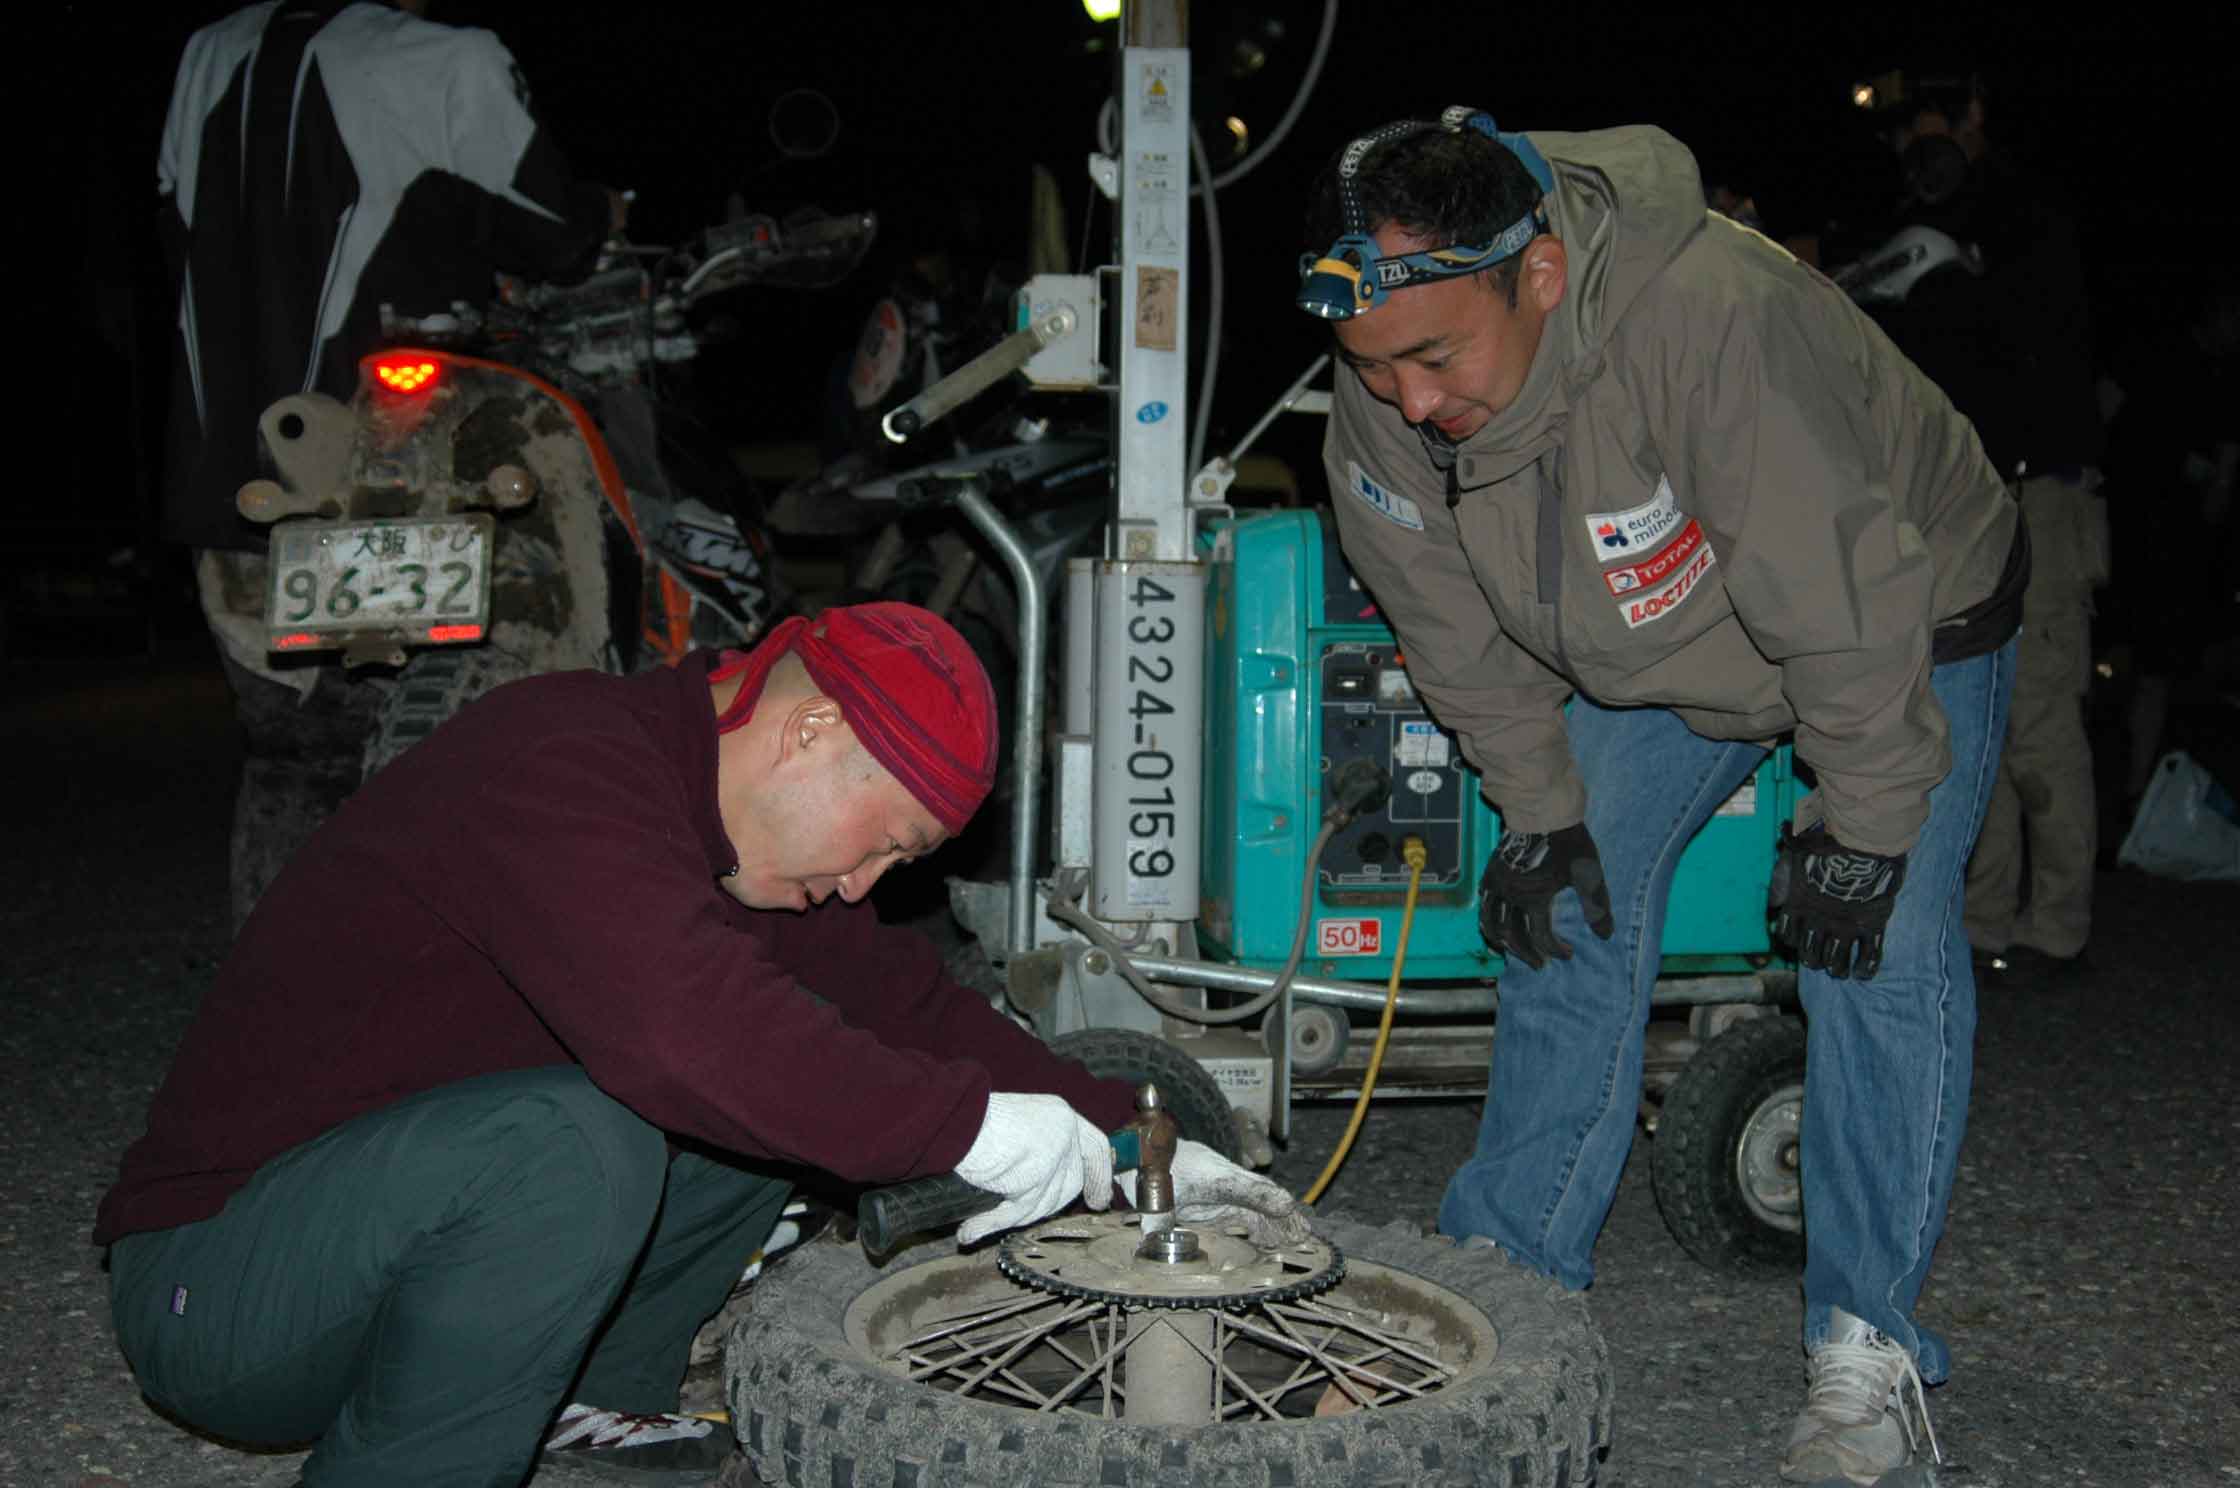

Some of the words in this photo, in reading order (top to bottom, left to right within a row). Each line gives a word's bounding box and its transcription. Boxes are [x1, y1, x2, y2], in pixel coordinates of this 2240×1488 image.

[1628, 508, 1661, 530] euro
[354, 528, 406, 557] 大阪
[1641, 534, 1697, 578] TOTAL
[285, 561, 472, 621] 96-32
[1631, 548, 1710, 624] LOCTITE
[1127, 577, 1175, 877] 4324-0159
[1325, 926, 1357, 948] 50
